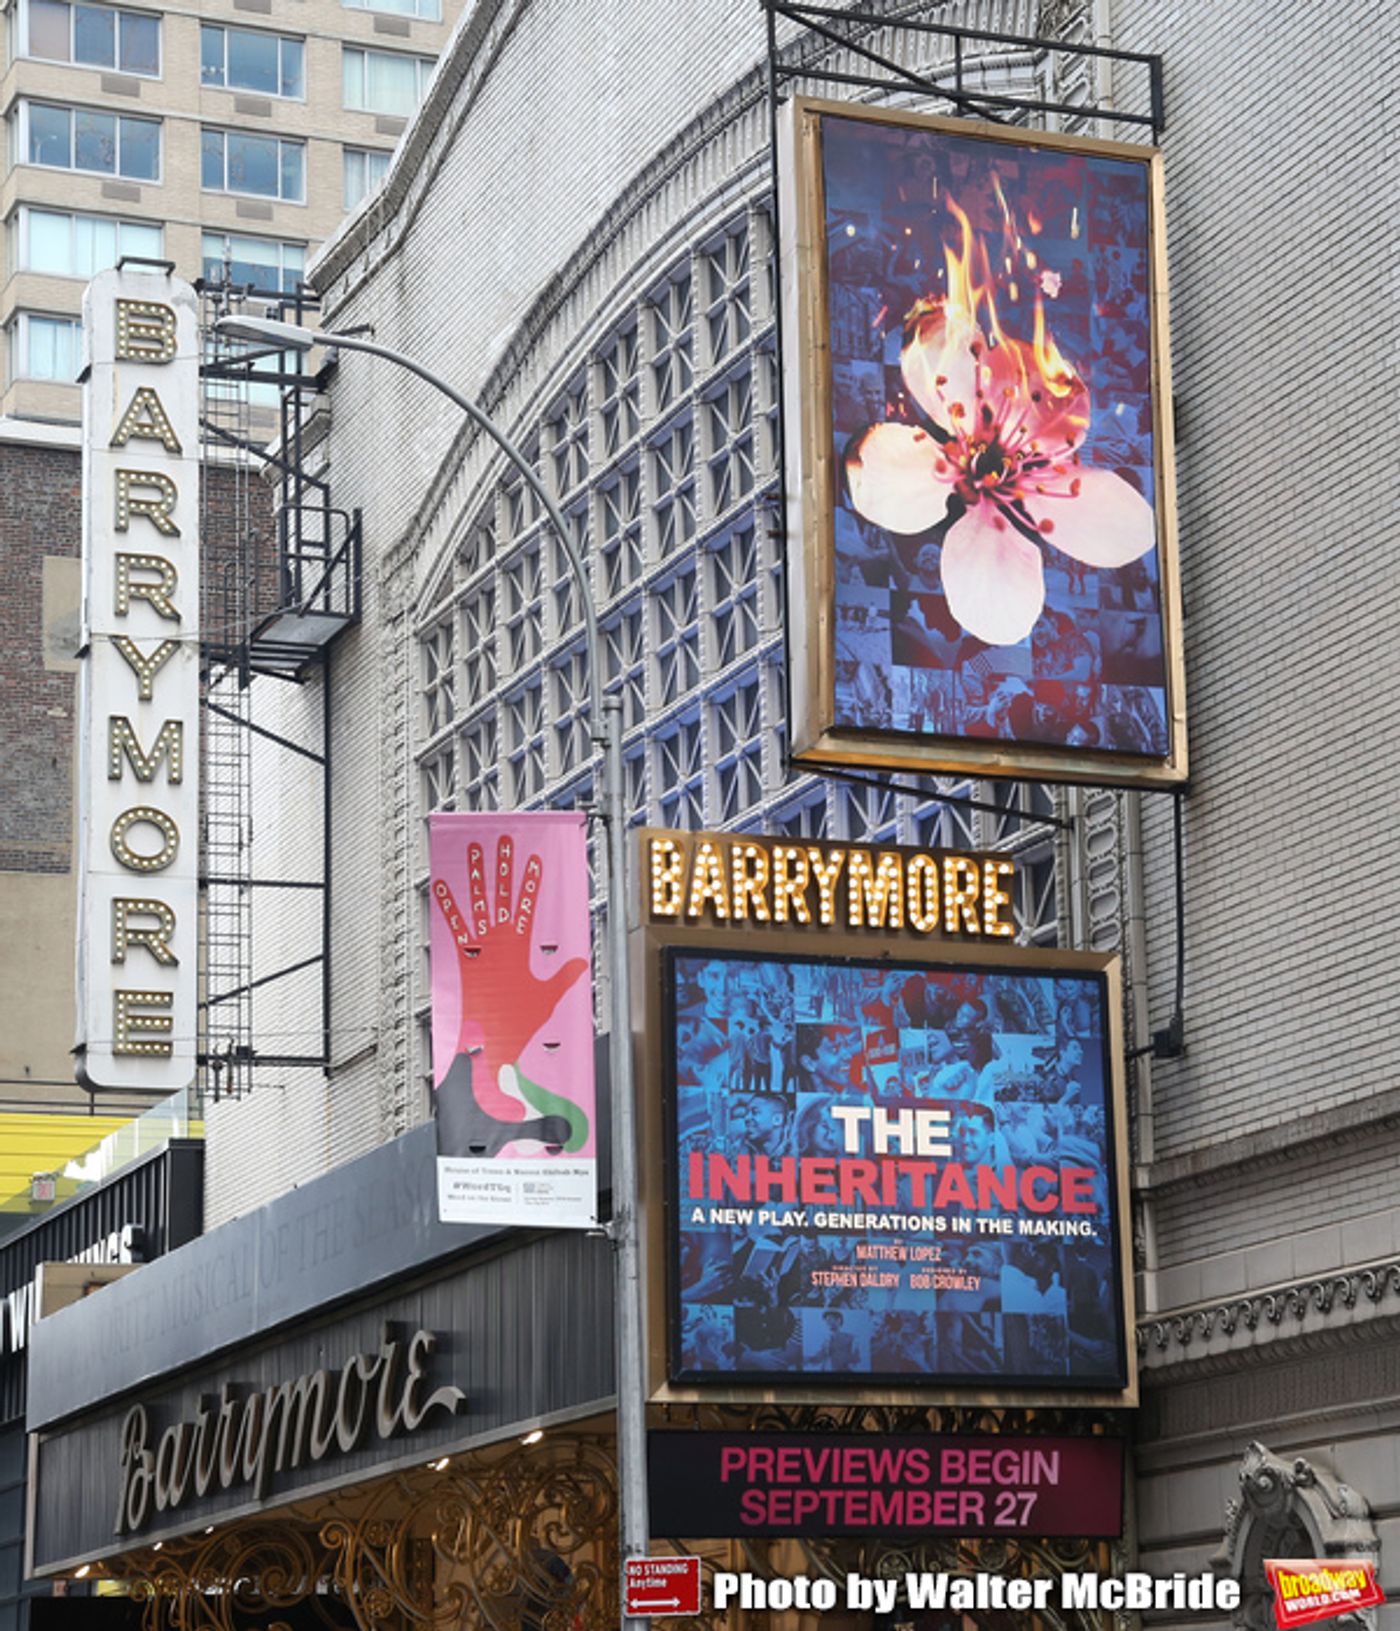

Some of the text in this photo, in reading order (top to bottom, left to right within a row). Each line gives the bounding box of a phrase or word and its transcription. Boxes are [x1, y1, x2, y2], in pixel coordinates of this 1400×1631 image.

[109, 298, 183, 1058] BARRYMORE
[471, 848, 488, 936] PALMS
[498, 844, 511, 923] HOLD
[516, 860, 541, 935] MORE
[651, 837, 1015, 938] BARRYMORE
[436, 884, 469, 944] OPEN
[831, 1106, 953, 1157] THE
[688, 1151, 1098, 1215] INHERITANCE
[691, 1207, 1098, 1237] A NEW PLAY. GENERATIONS IN THE MAKING.
[855, 1244, 942, 1262] MATTHEW LOPEZ
[811, 1271, 858, 1288] STEPHEN
[909, 1274, 981, 1291] BOB CROWLEY
[113, 1328, 466, 1537] Barrymore
[720, 1447, 1060, 1486] PREVIEWS BEGIN
[739, 1489, 1038, 1527] SEPTEMBER 27
[629, 1563, 688, 1576] NO STANDING
[629, 1577, 668, 1591] Anytime
